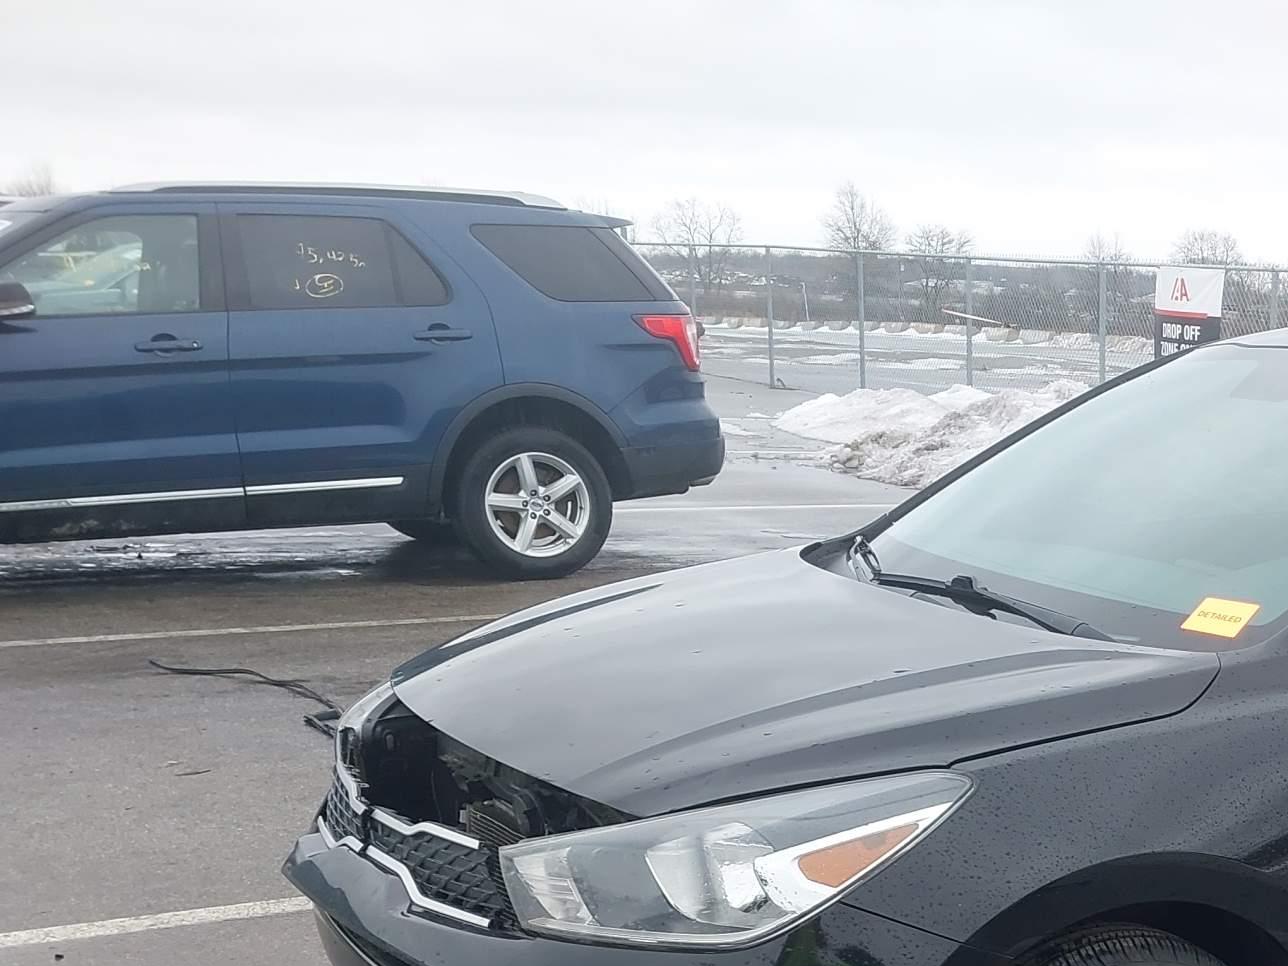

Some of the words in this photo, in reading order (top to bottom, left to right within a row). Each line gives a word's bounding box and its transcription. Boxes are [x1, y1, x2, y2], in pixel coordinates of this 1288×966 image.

[1162, 323, 1181, 339] DROP
[1184, 325, 1201, 341] OFF
[1197, 610, 1242, 623] DETAILED
